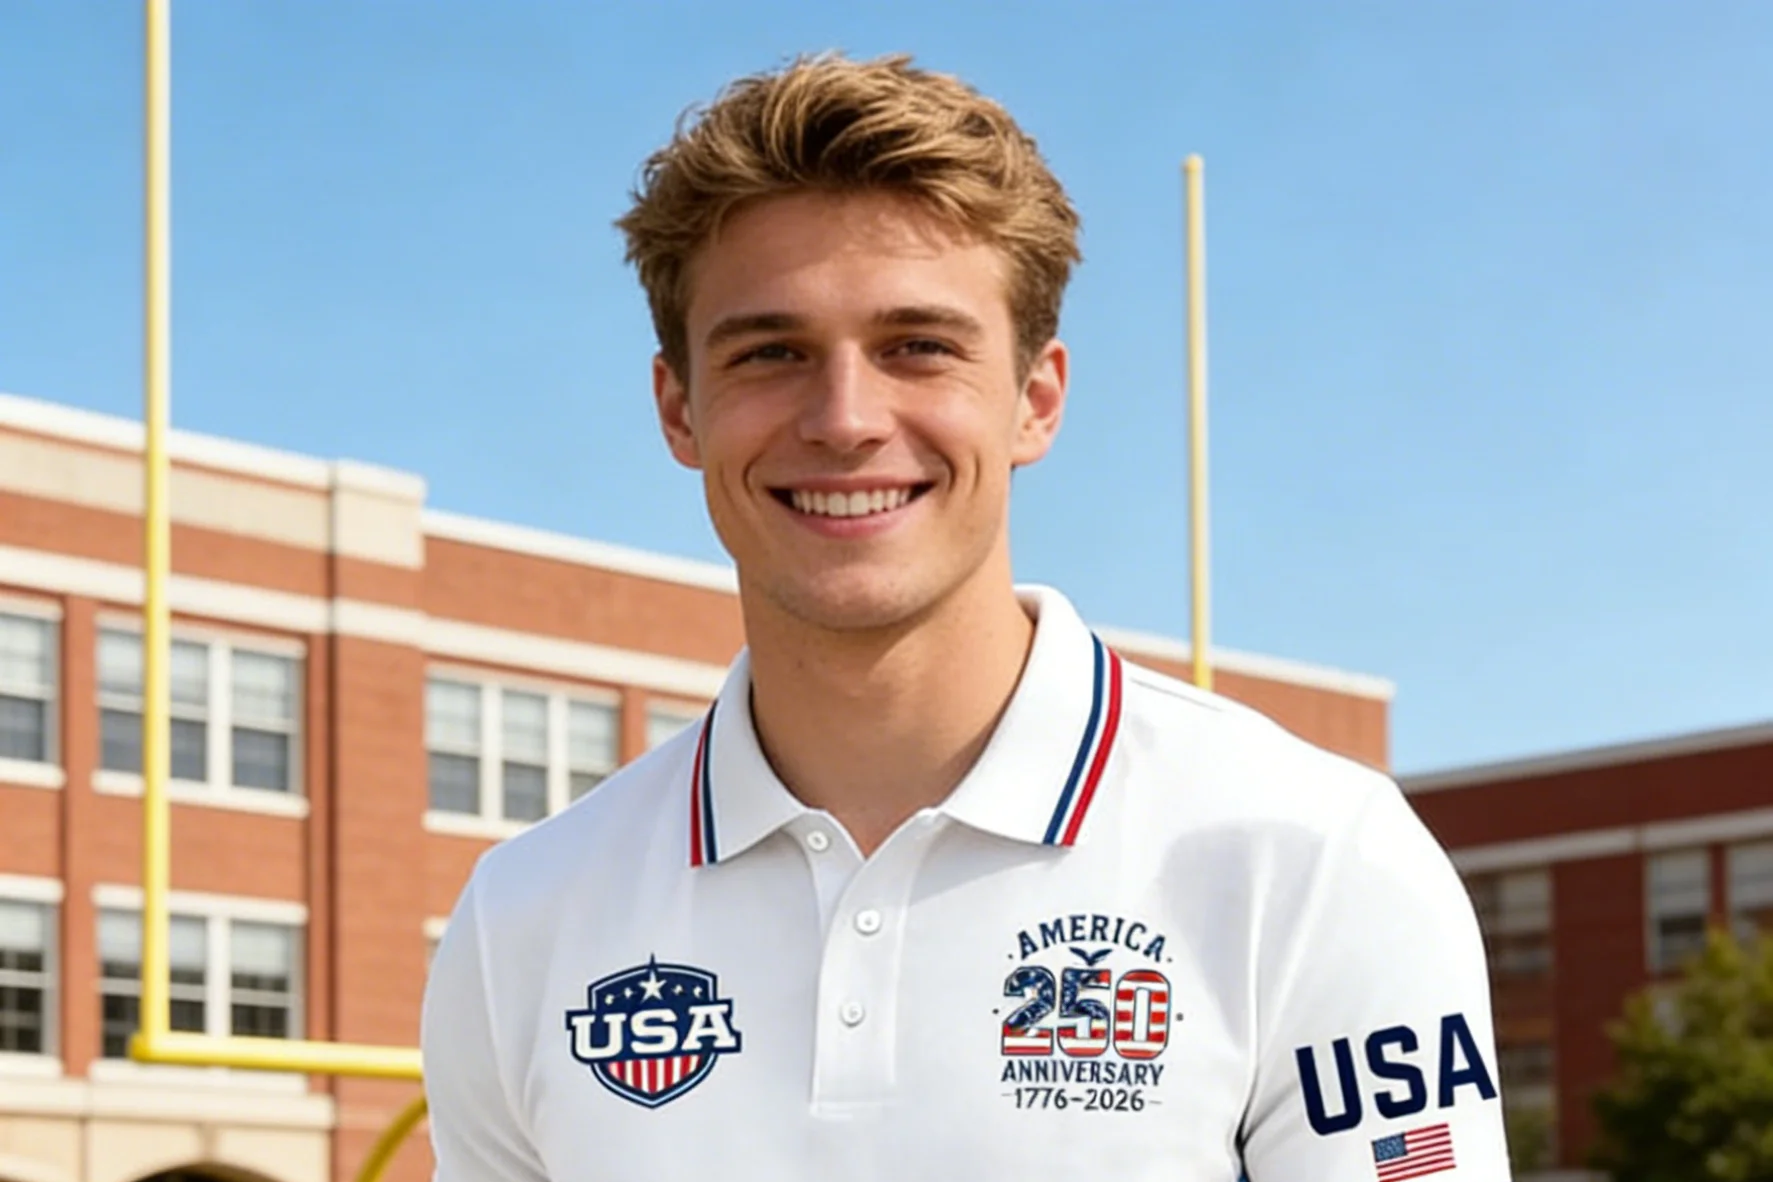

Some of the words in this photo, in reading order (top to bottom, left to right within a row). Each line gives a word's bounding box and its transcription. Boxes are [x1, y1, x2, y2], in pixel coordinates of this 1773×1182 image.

[1016, 913, 1166, 963] AMERICA
[570, 1003, 738, 1060] USA
[1001, 965, 1172, 1060] 250
[1001, 1059, 1164, 1087] ANNIVERSARY
[1294, 1012, 1498, 1137] USA
